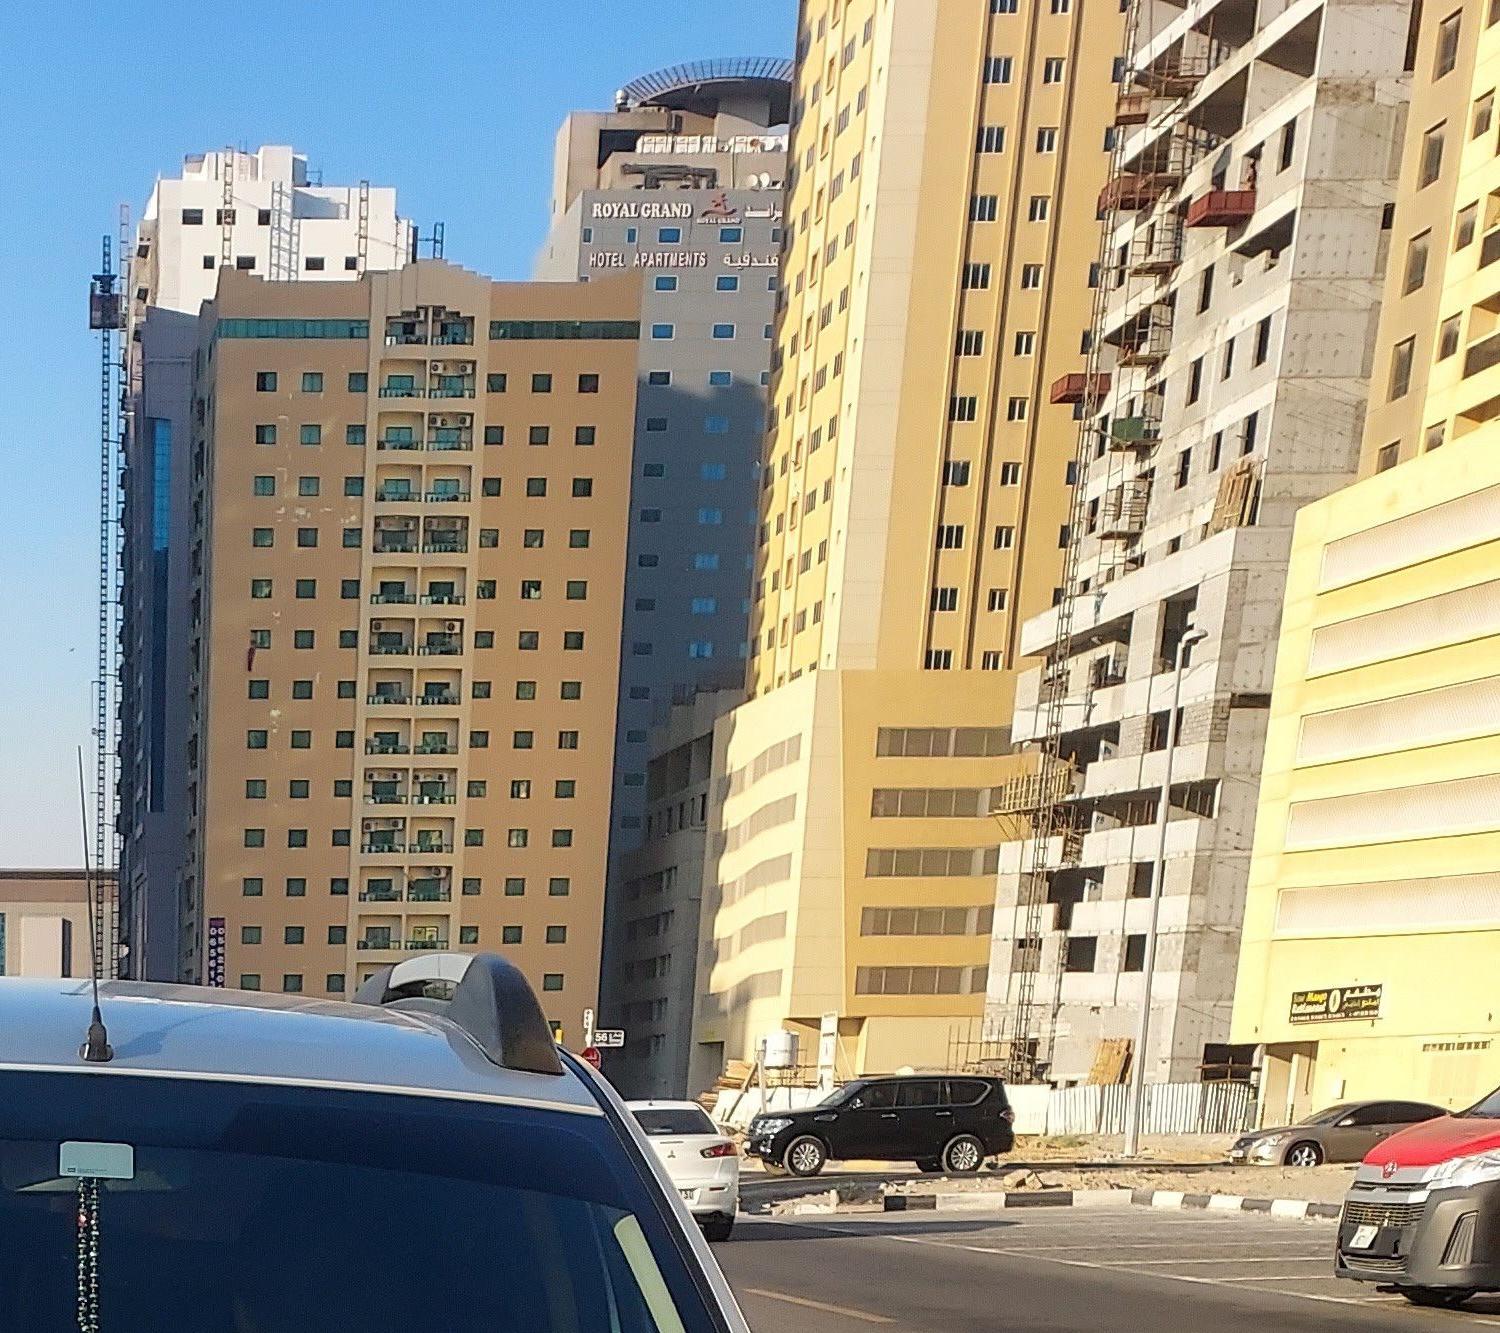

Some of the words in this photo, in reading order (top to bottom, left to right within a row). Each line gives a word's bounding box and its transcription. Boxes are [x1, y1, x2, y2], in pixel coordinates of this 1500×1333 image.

[593, 202, 640, 219] ROYAL
[641, 202, 693, 219] GRAND
[589, 252, 625, 267] HOTEL
[634, 252, 707, 268] APARTMENTS
[595, 1032, 608, 1042] 56
